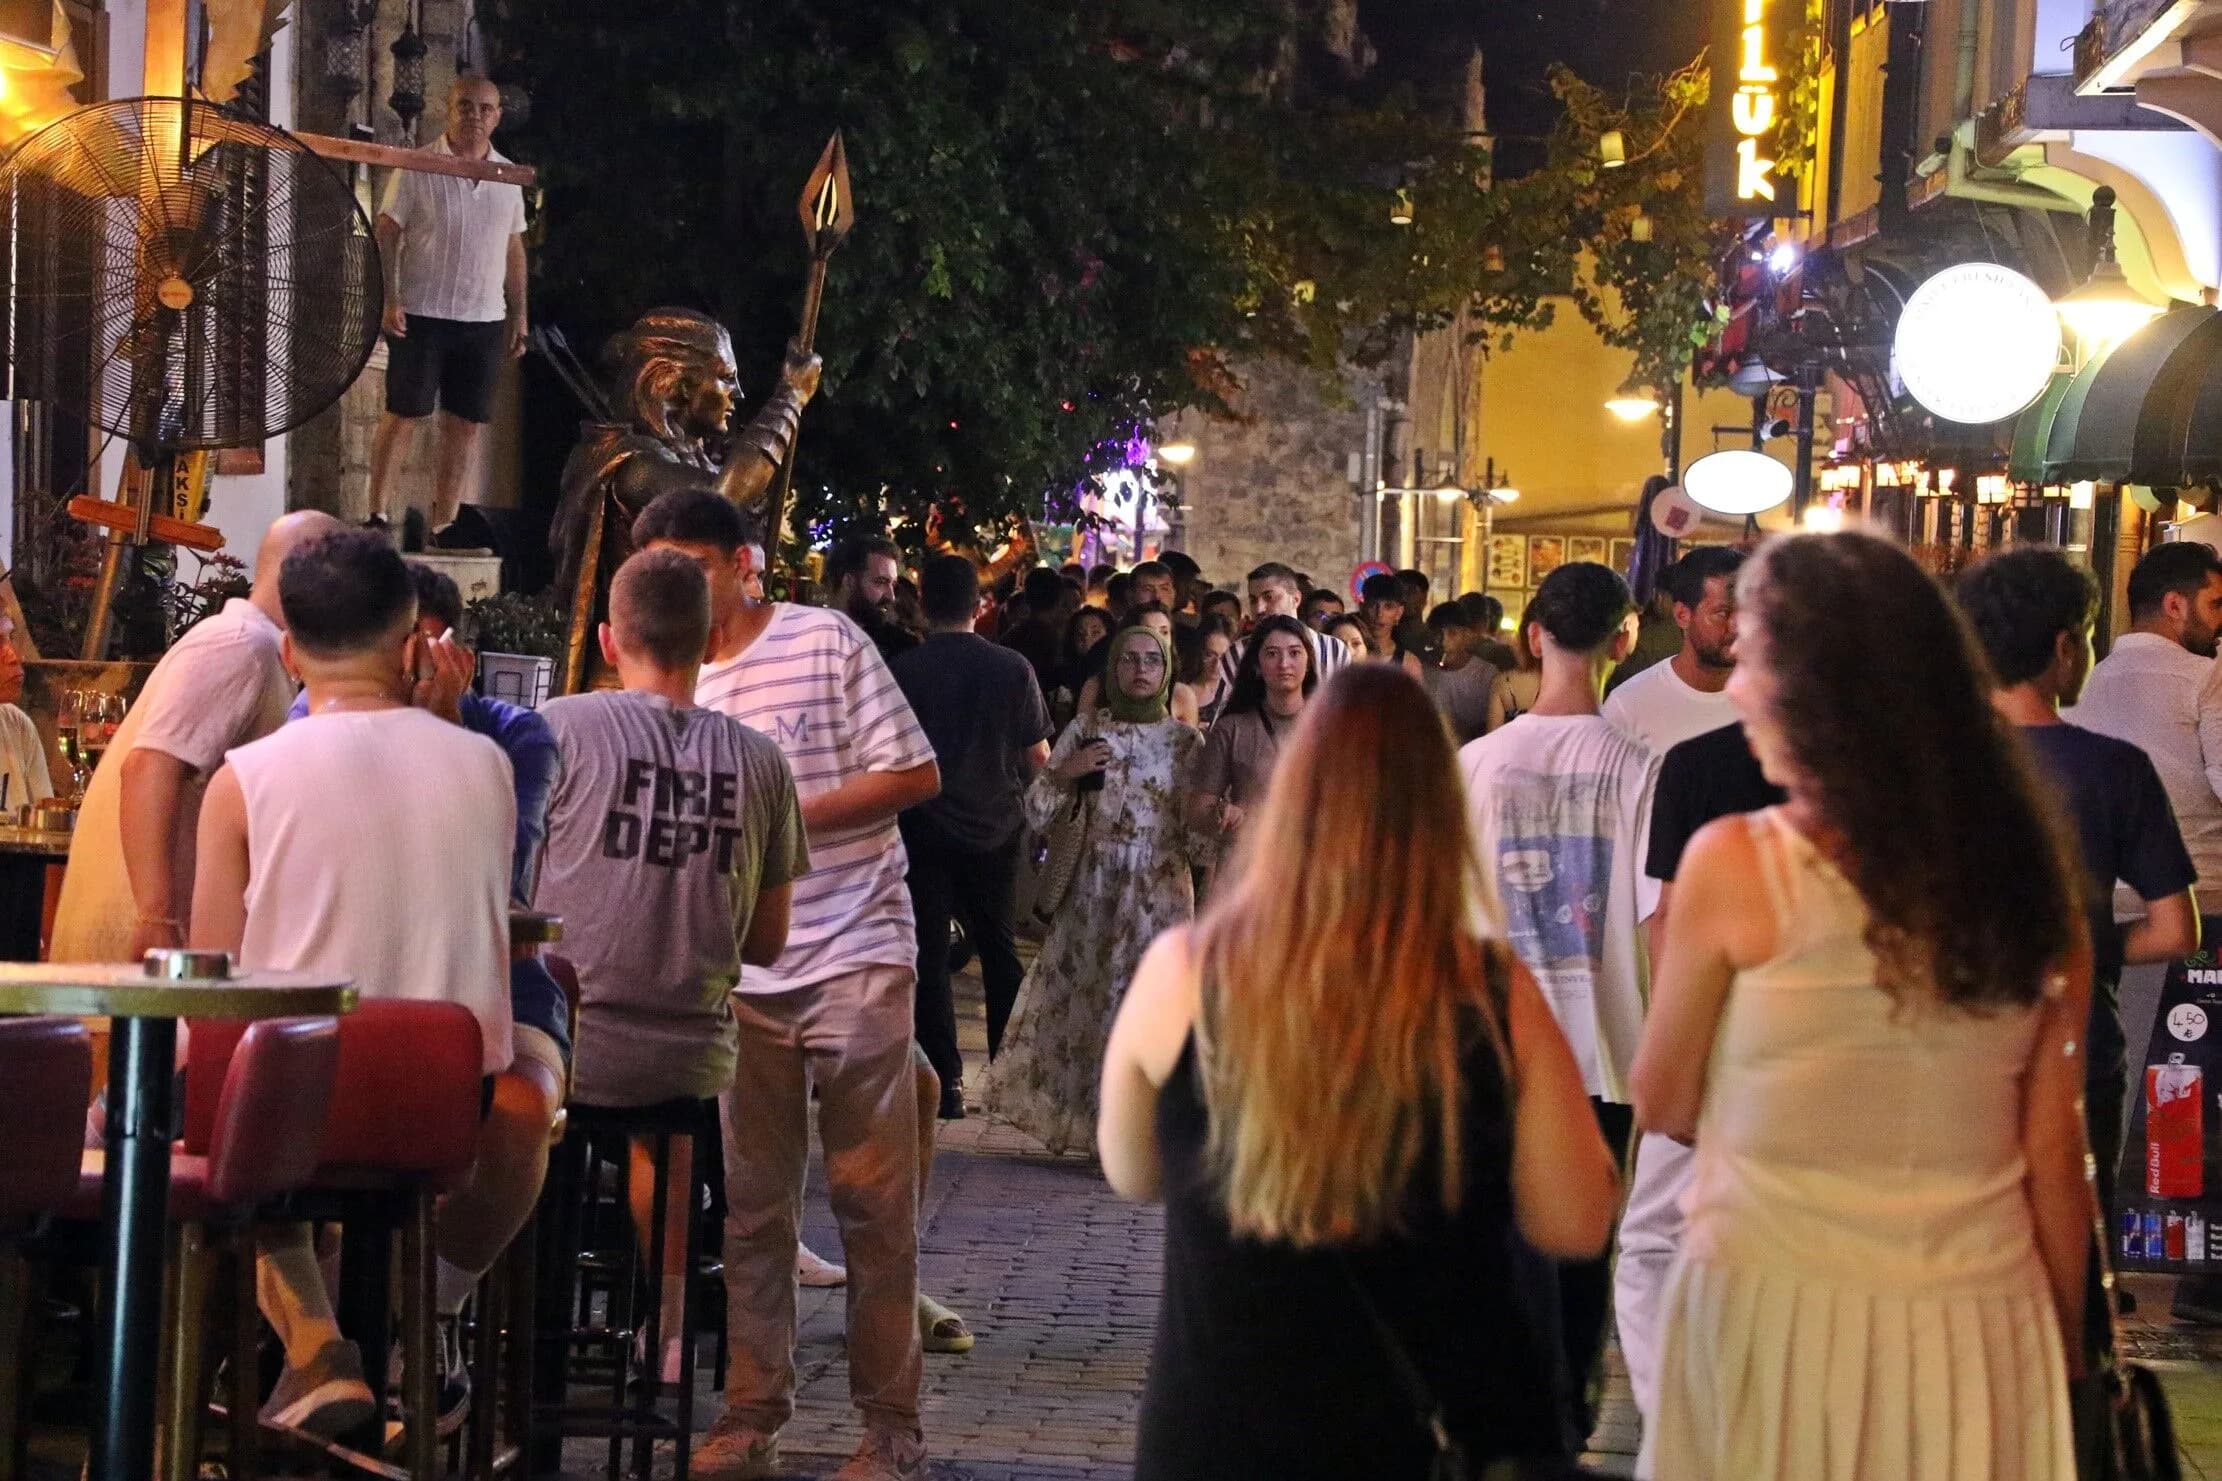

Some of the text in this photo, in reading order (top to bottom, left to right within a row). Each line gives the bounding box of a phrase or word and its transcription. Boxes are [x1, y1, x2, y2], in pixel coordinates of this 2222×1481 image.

[775, 712, 809, 745] M
[622, 759, 738, 819] FIRE
[602, 810, 743, 874] DEPT
